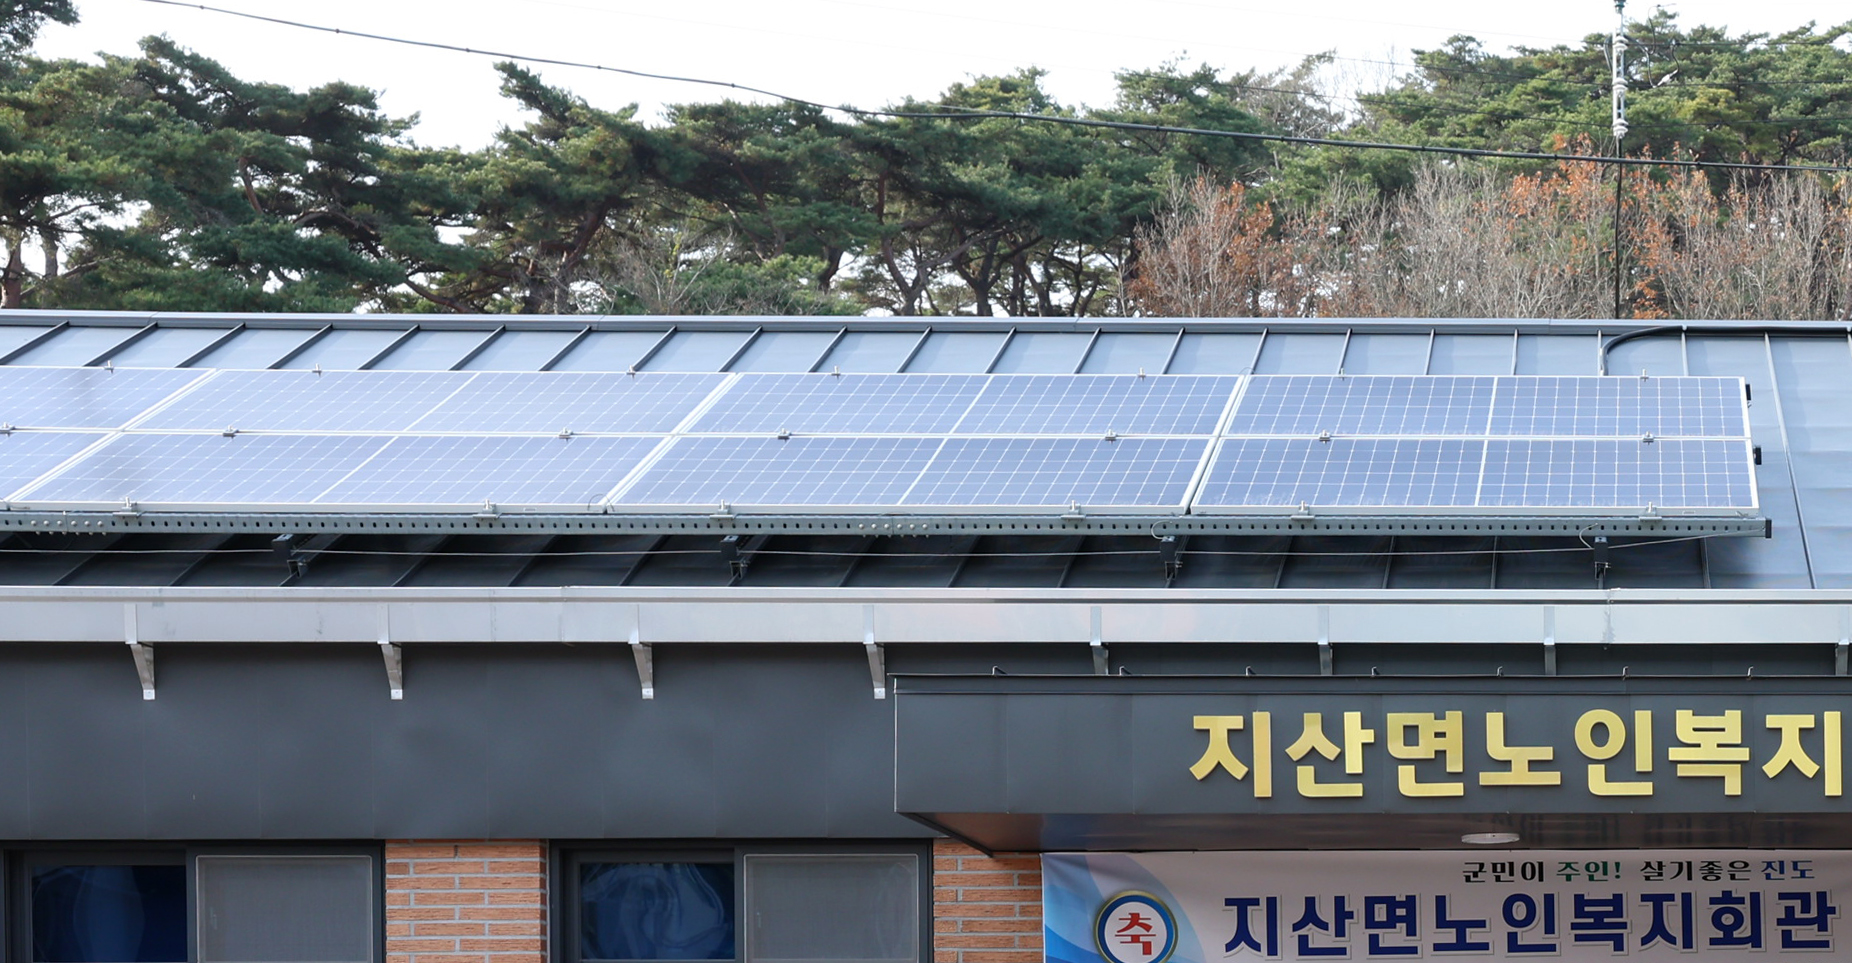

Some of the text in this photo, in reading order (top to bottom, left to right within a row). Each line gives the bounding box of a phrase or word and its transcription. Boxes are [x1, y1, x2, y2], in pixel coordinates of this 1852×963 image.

[1462, 859, 1816, 883] 군민이 주인! 살기좋은 진도
[1114, 912, 1157, 956] 축
[1222, 890, 1840, 959] 지산면노인복지회관
